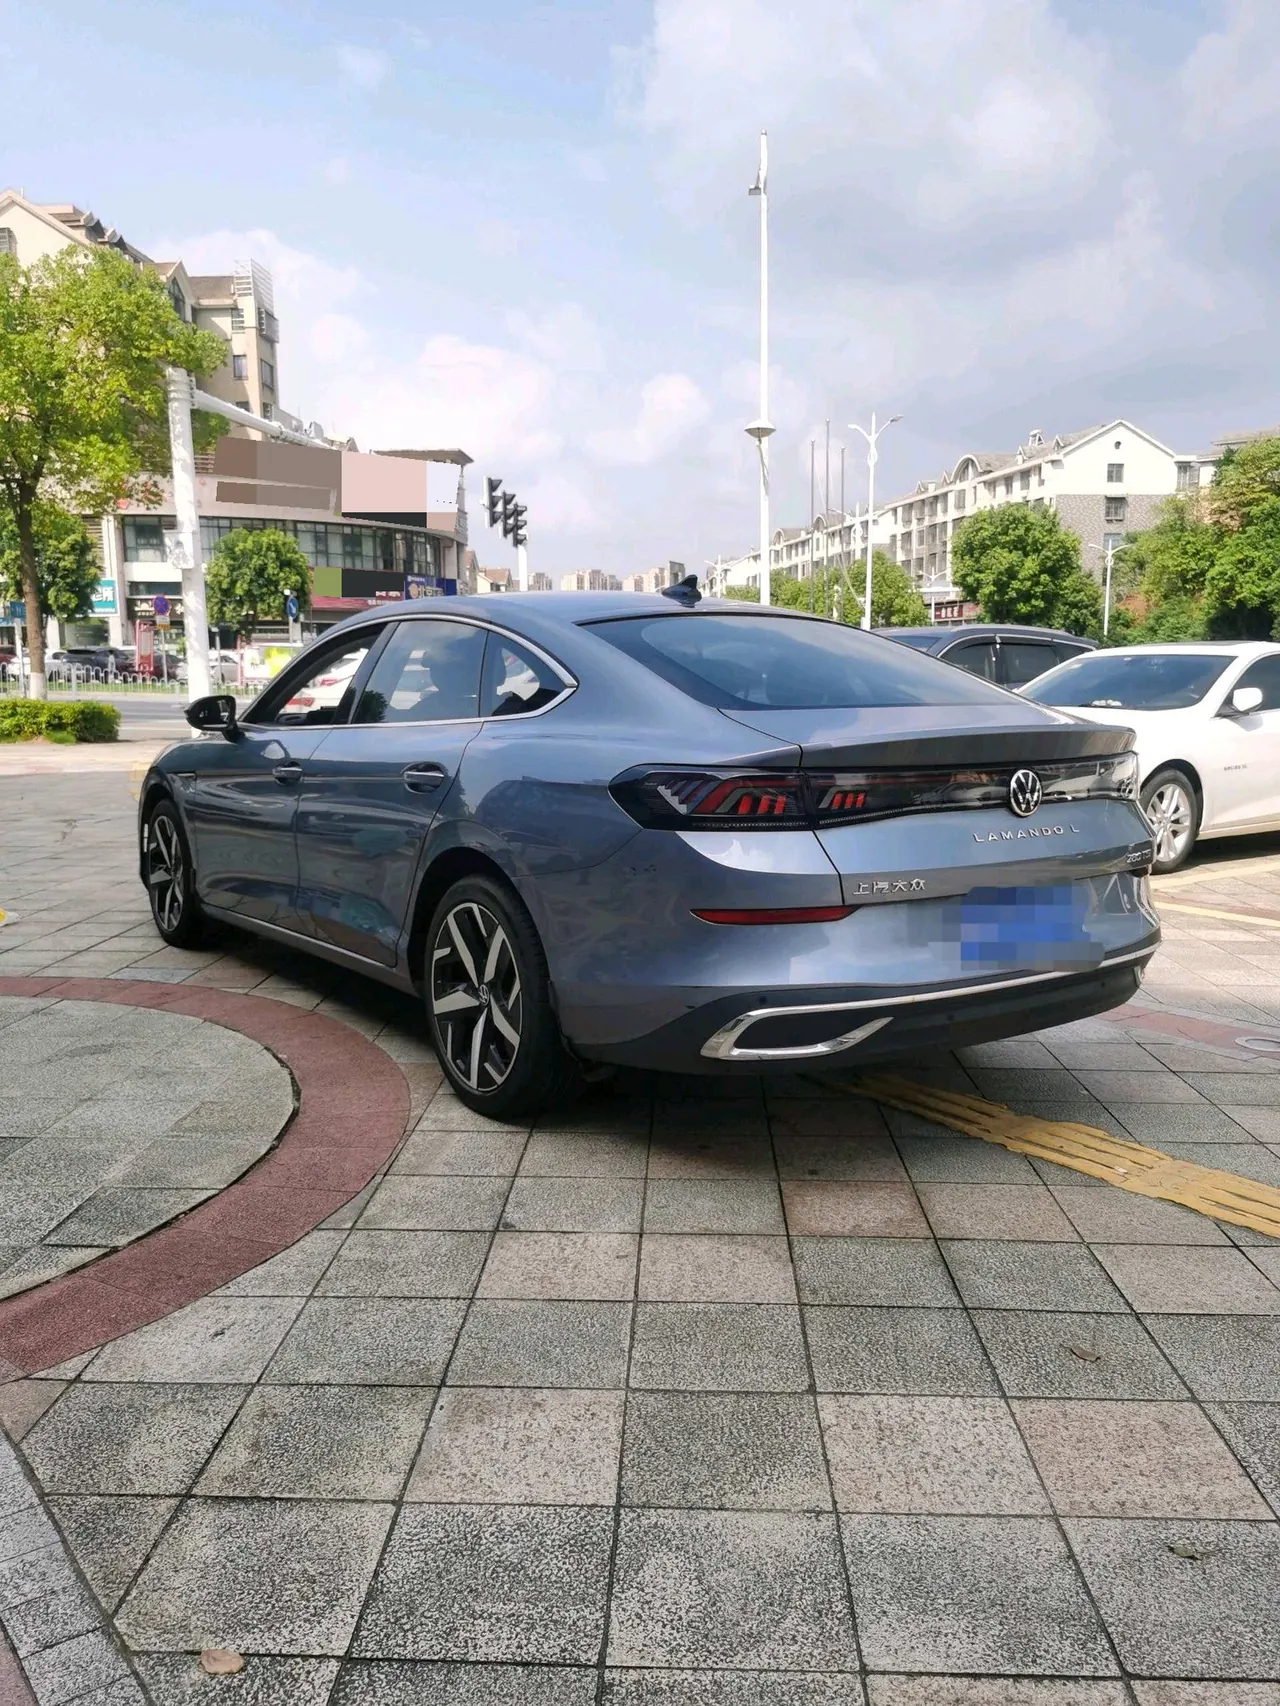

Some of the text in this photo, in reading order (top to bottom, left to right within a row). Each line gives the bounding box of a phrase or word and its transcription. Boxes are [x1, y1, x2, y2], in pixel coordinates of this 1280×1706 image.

[972, 823, 1081, 843] LAMANDO L
[1126, 851, 1142, 863] 280
[853, 878, 926, 895] 上汽大众
